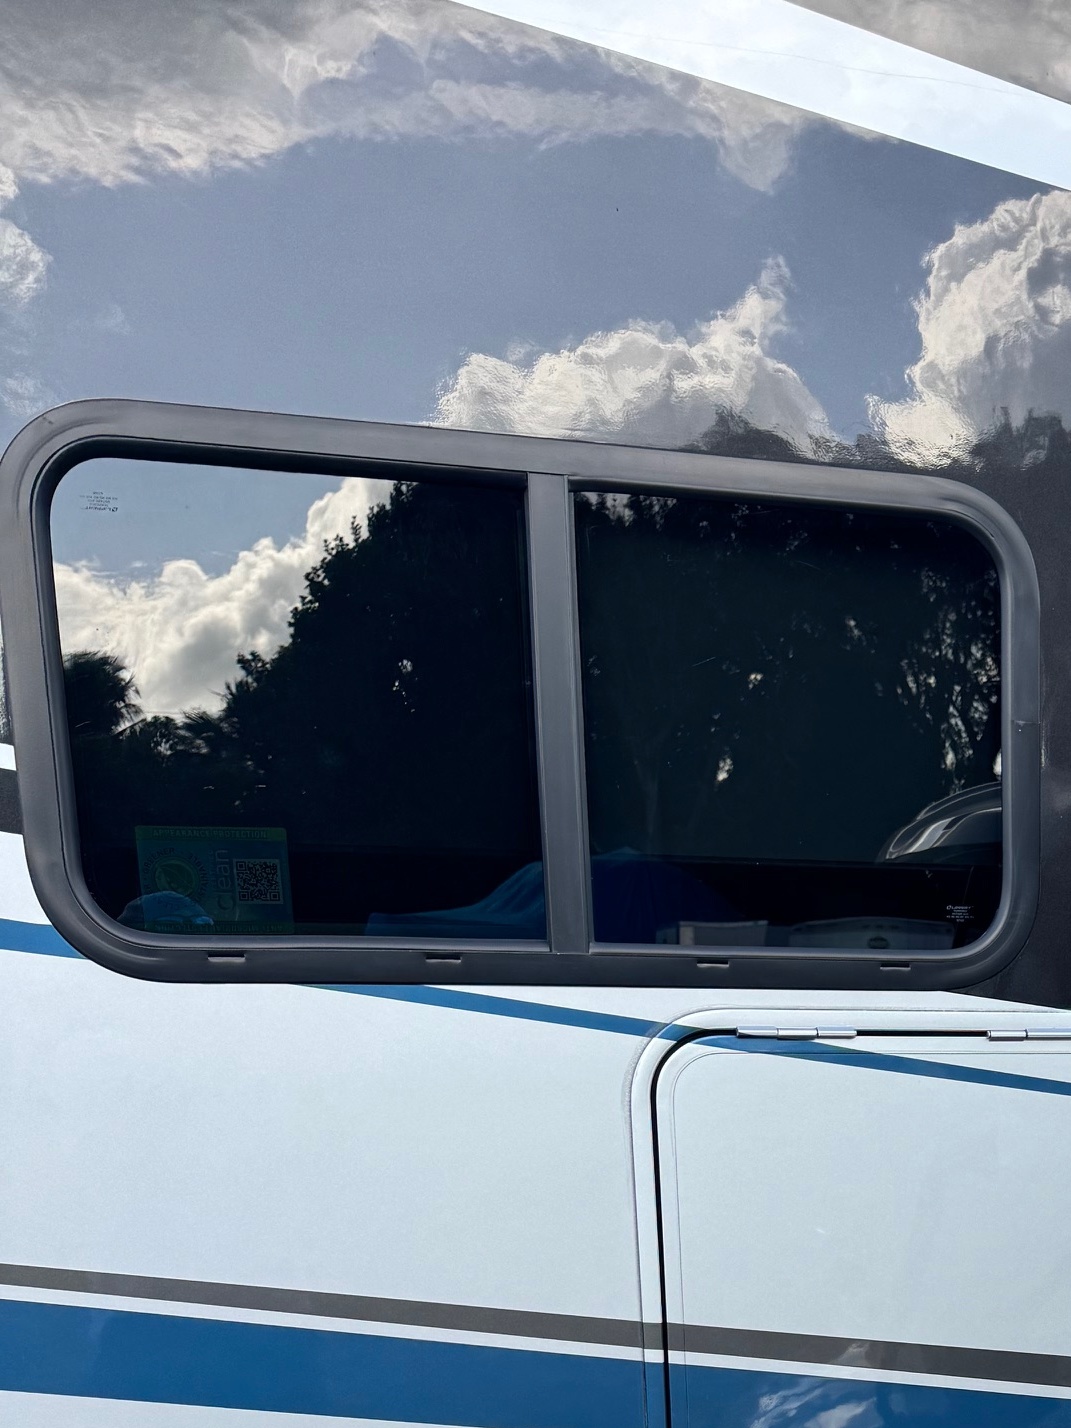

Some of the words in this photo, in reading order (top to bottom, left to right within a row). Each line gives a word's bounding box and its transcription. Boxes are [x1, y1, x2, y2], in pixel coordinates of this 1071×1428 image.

[153, 829, 210, 839] APPEARANCE
[213, 829, 267, 839] PROTECTION
[213, 849, 236, 911] clean
